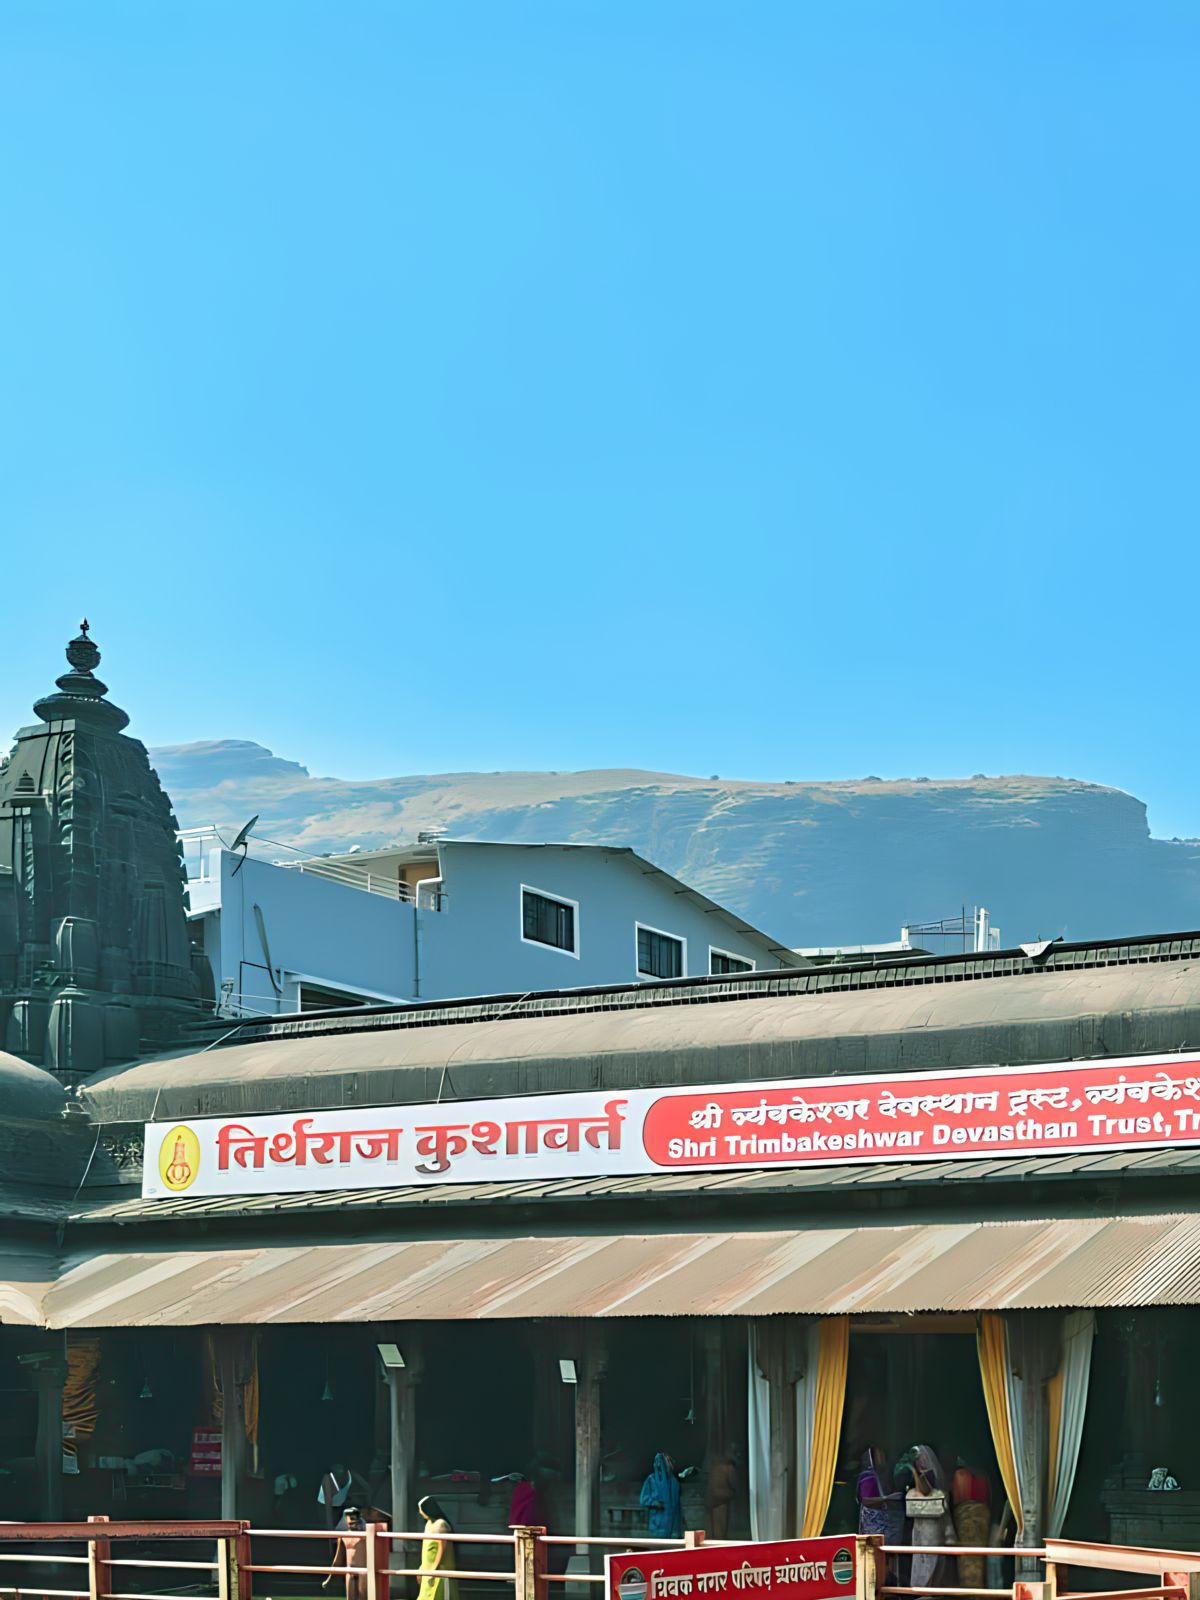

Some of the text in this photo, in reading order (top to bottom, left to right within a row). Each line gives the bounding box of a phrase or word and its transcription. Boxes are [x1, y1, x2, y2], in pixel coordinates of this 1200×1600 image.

[688, 1102, 723, 1129] श्री
[878, 1091, 1000, 1119] देवस्थान
[216, 1099, 630, 1174] तिर्थराज कुशावर्त
[668, 1135, 717, 1159] Shri
[724, 1129, 924, 1156] Trimbakeshwar
[933, 1115, 1078, 1145] Devasthan
[696, 1571, 728, 1593] नगर
